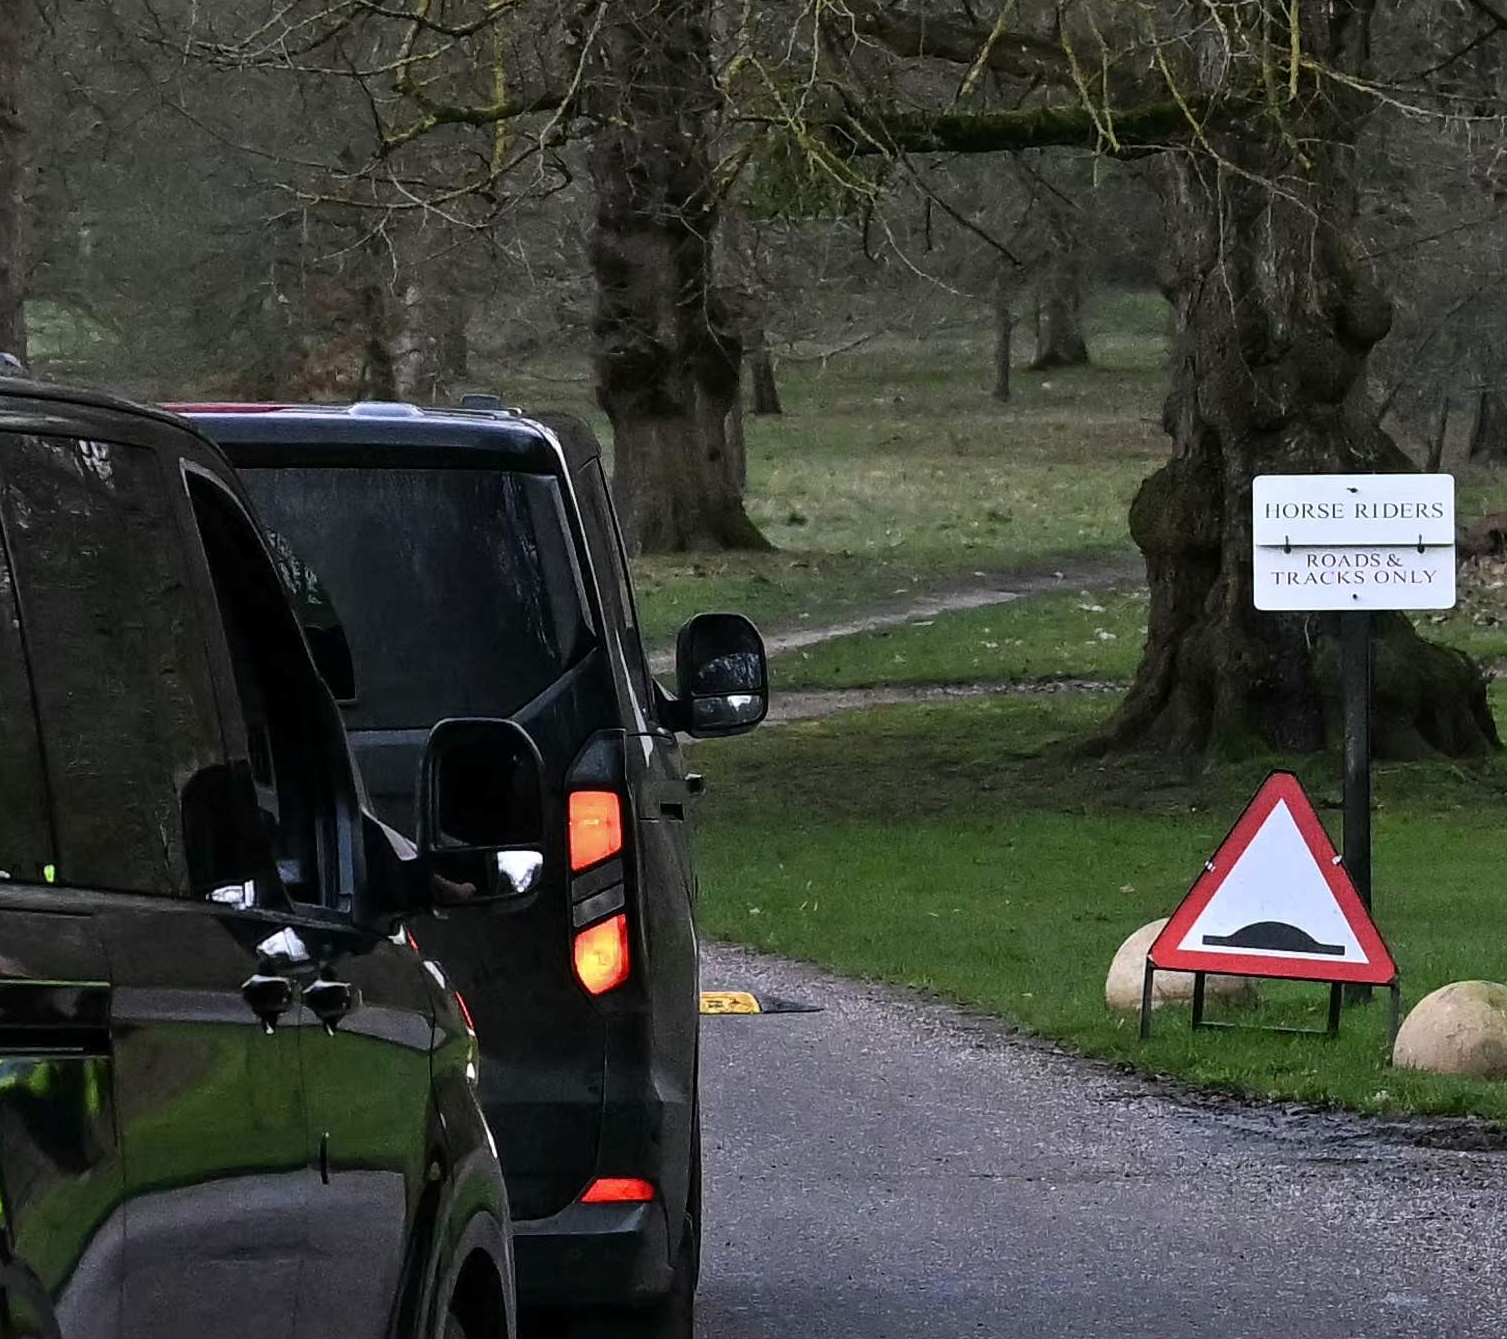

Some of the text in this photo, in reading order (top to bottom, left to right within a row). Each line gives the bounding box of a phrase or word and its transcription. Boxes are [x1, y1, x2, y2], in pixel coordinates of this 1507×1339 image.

[1264, 502, 1444, 519] HORSE RIDERS
[1307, 553, 1404, 568] ROADS &
[1271, 569, 1437, 585] TRACKS ONLY
